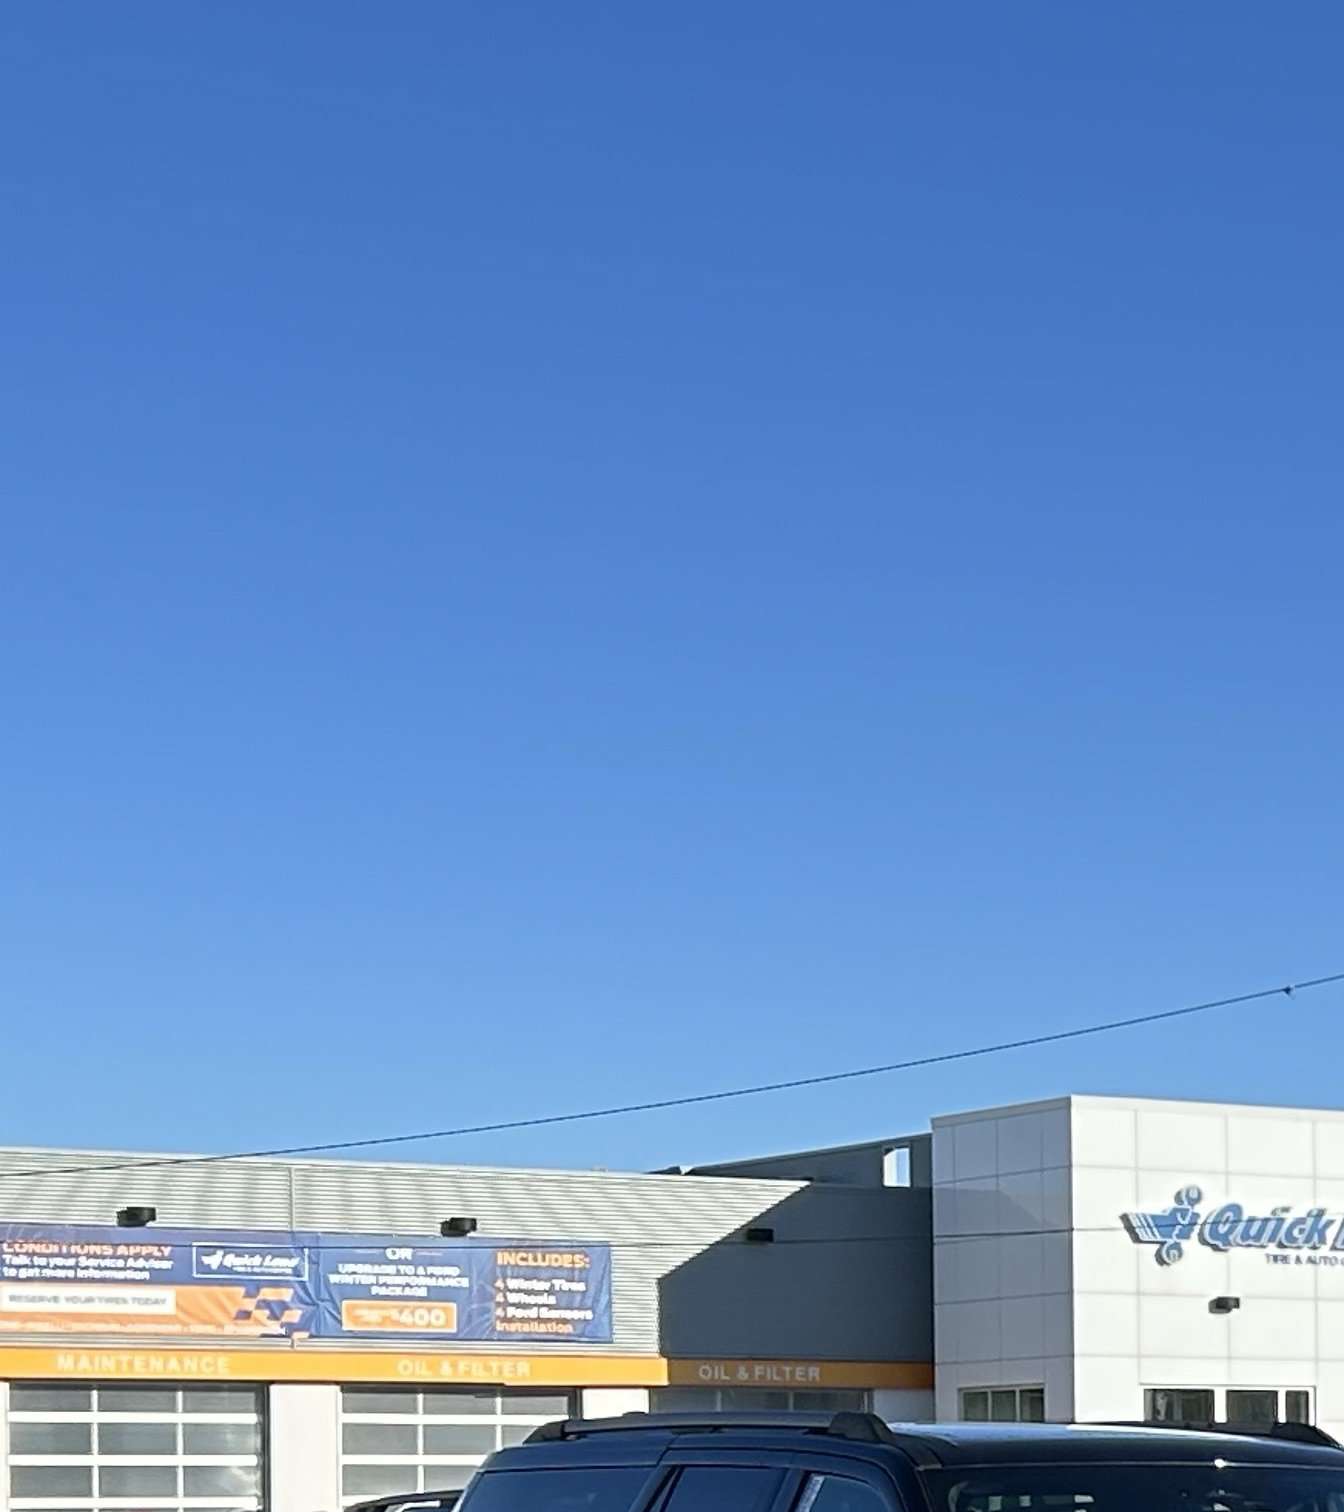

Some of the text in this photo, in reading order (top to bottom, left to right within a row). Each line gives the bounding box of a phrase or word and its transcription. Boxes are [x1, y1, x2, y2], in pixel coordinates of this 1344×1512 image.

[1199, 1204, 1335, 1252] Quick
[117, 1244, 172, 1256] APPLY
[385, 1248, 412, 1260] OR
[2, 1255, 31, 1266] Talk
[33, 1256, 47, 1266] to
[49, 1256, 76, 1268] your
[78, 1256, 125, 1268] Service
[223, 1253, 300, 1268] Quick Lane
[497, 1252, 590, 1268] INCLUDES:
[1265, 1254, 1291, 1265] TIRE
[1294, 1255, 1304, 1265] &
[1306, 1255, 1338, 1266] AUTO
[2, 1267, 150, 1280] to get more information
[398, 1265, 415, 1275] TO
[328, 1274, 469, 1288] WINTER PERFORMANCE
[506, 1279, 550, 1291] Winter
[551, 1279, 586, 1291] Tires
[370, 1286, 427, 1297] PACKAGE
[506, 1292, 557, 1305] Wheels
[506, 1306, 539, 1318] Ford
[539, 1307, 593, 1320] Sensors
[496, 1320, 573, 1333] Installation
[57, 1354, 231, 1374] MAINTENANCE
[397, 1360, 531, 1377] OIL & FILTER
[699, 1365, 821, 1381] OIL & FILTER
